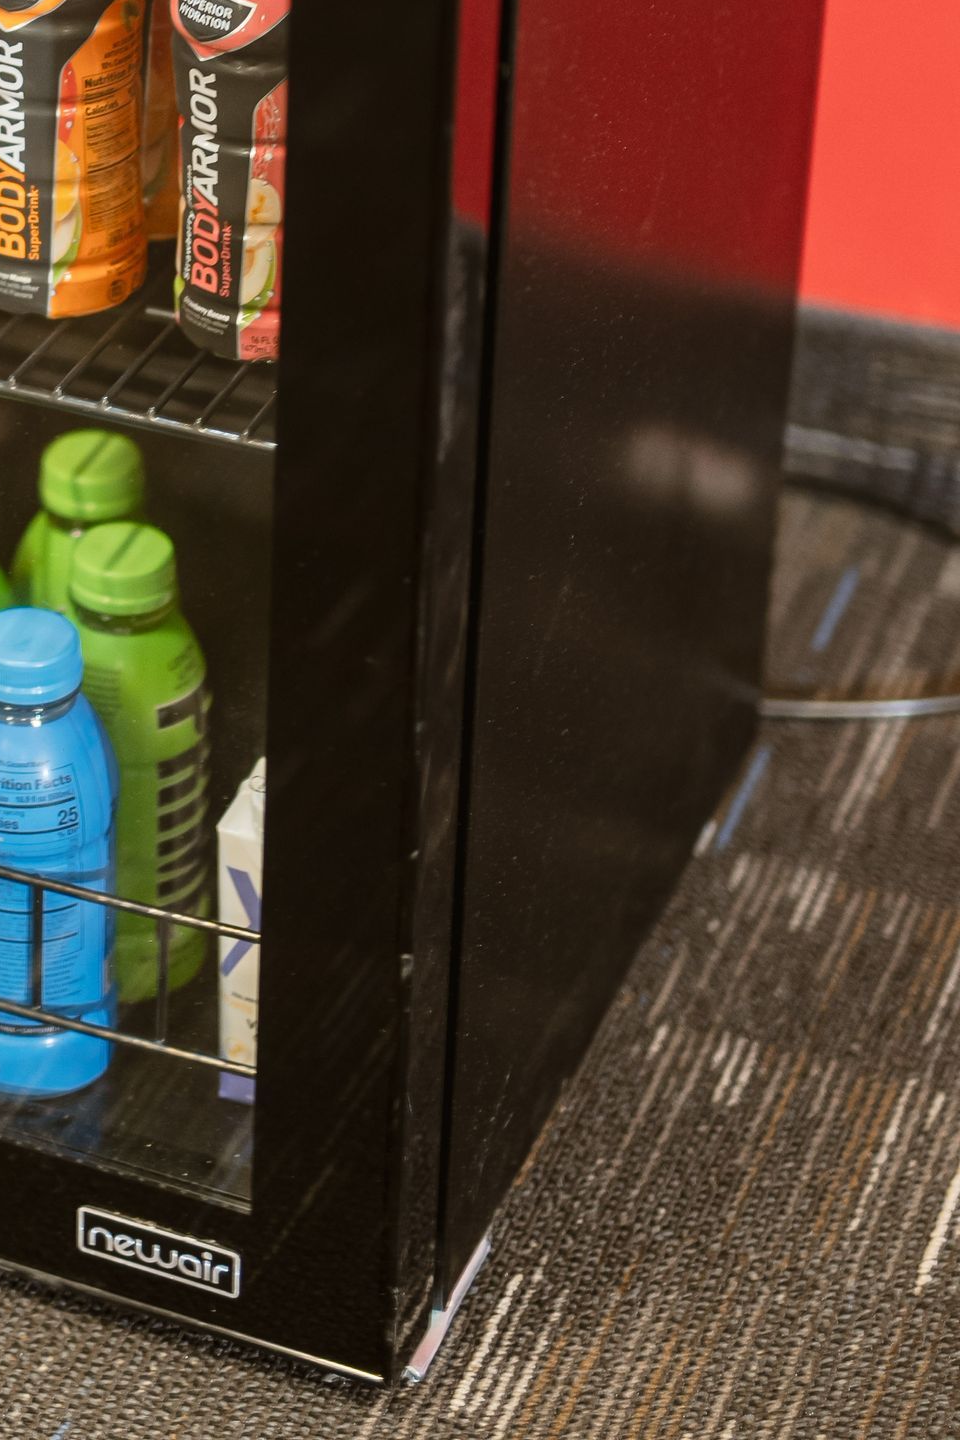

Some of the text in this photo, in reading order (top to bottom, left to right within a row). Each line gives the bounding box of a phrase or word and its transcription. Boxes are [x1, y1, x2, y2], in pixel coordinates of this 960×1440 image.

[179, 3, 232, 32] HYDRATION
[34, 774, 73, 791] Facts
[57, 806, 79, 826] 25
[87, 1225, 230, 1285] newair
